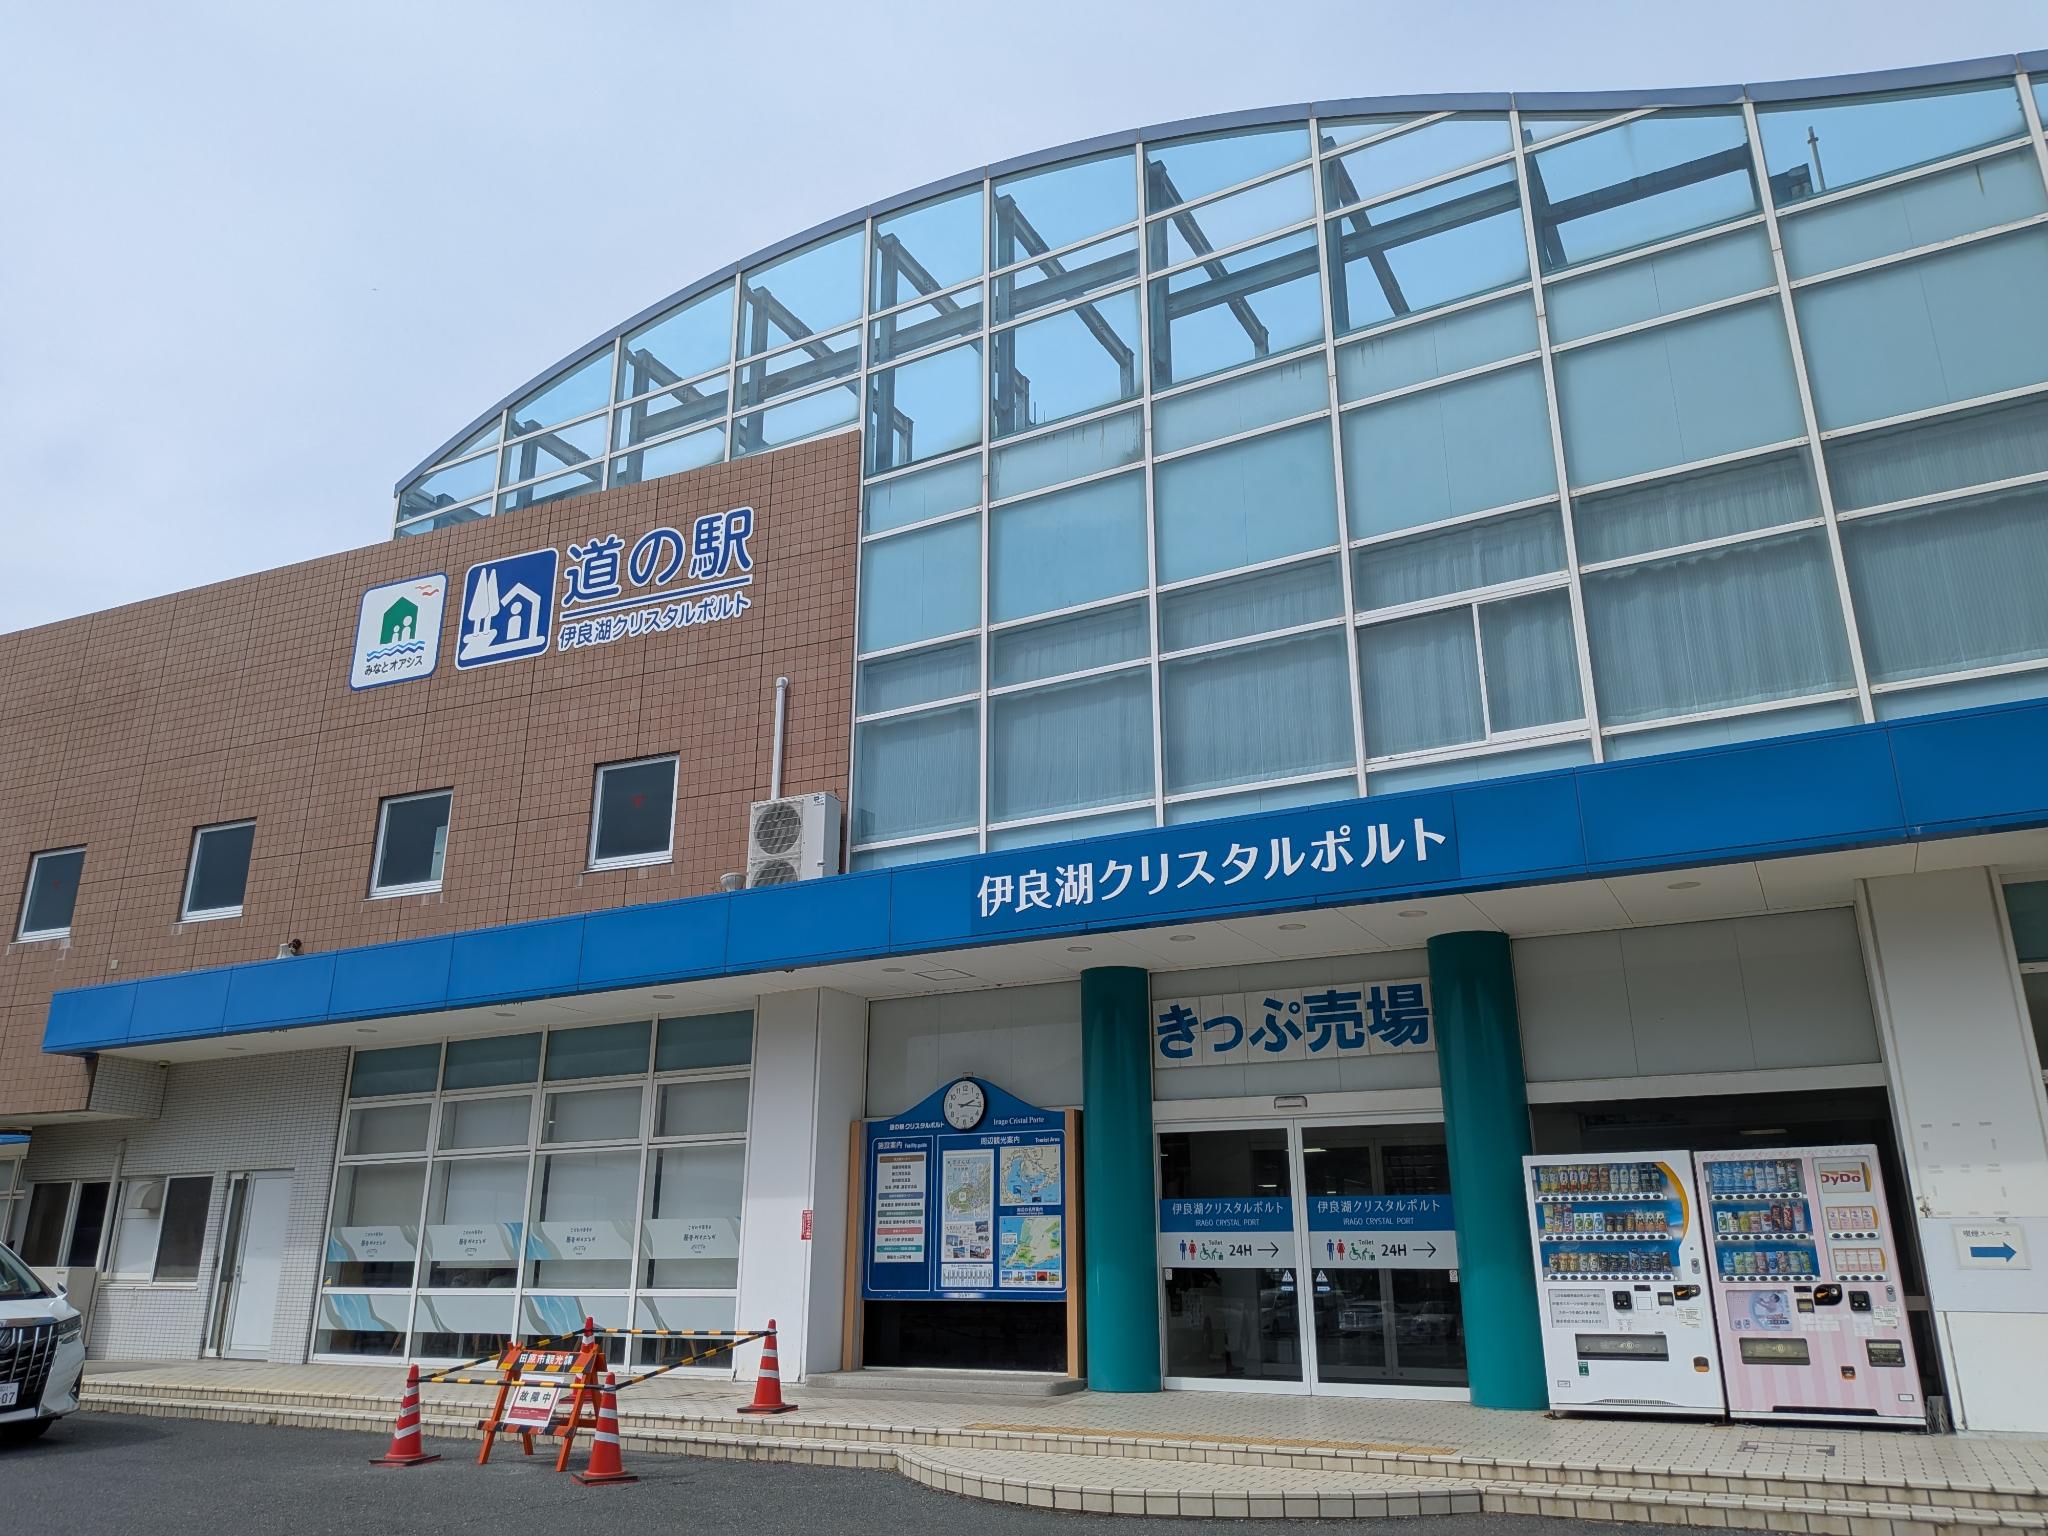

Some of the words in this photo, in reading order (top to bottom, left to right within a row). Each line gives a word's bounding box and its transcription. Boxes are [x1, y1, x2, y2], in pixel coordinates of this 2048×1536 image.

[562, 508, 753, 606] 道の駅
[559, 593, 750, 650] 伊良湖クリスタルポルト
[364, 655, 423, 676] みなとオアシス
[977, 817, 1447, 918] 伊良湖クリスタルポルト
[1156, 983, 1431, 1059] きっぷ売場
[993, 1117, 1008, 1126] Irago
[1009, 1116, 1027, 1125] Cristal
[1028, 1116, 1044, 1124] Porte
[877, 1141, 903, 1150] 施設案内
[980, 1136, 1020, 1145] 周辺観光案内
[1820, 1173, 1861, 1186] DyDo
[1172, 1201, 1284, 1216] 伊良湖クリスタルポルト
[1317, 1199, 1441, 1213] 伊良湖クリスタルポルト
[1195, 1218, 1214, 1227] IRAGO
[1215, 1218, 1241, 1227] CRYSTAL
[1243, 1218, 1260, 1226] PORT
[1343, 1217, 1363, 1226] IRAGO
[1366, 1217, 1393, 1225] CRYSTAL
[1397, 1217, 1414, 1225] PORT
[1962, 1230, 2011, 1238] 喫煙スペース
[1229, 1244, 1252, 1256] 24H
[1381, 1243, 1407, 1257] 24H
[519, 1353, 574, 1366] 田原市観光課
[519, 1390, 552, 1403] 故障中
